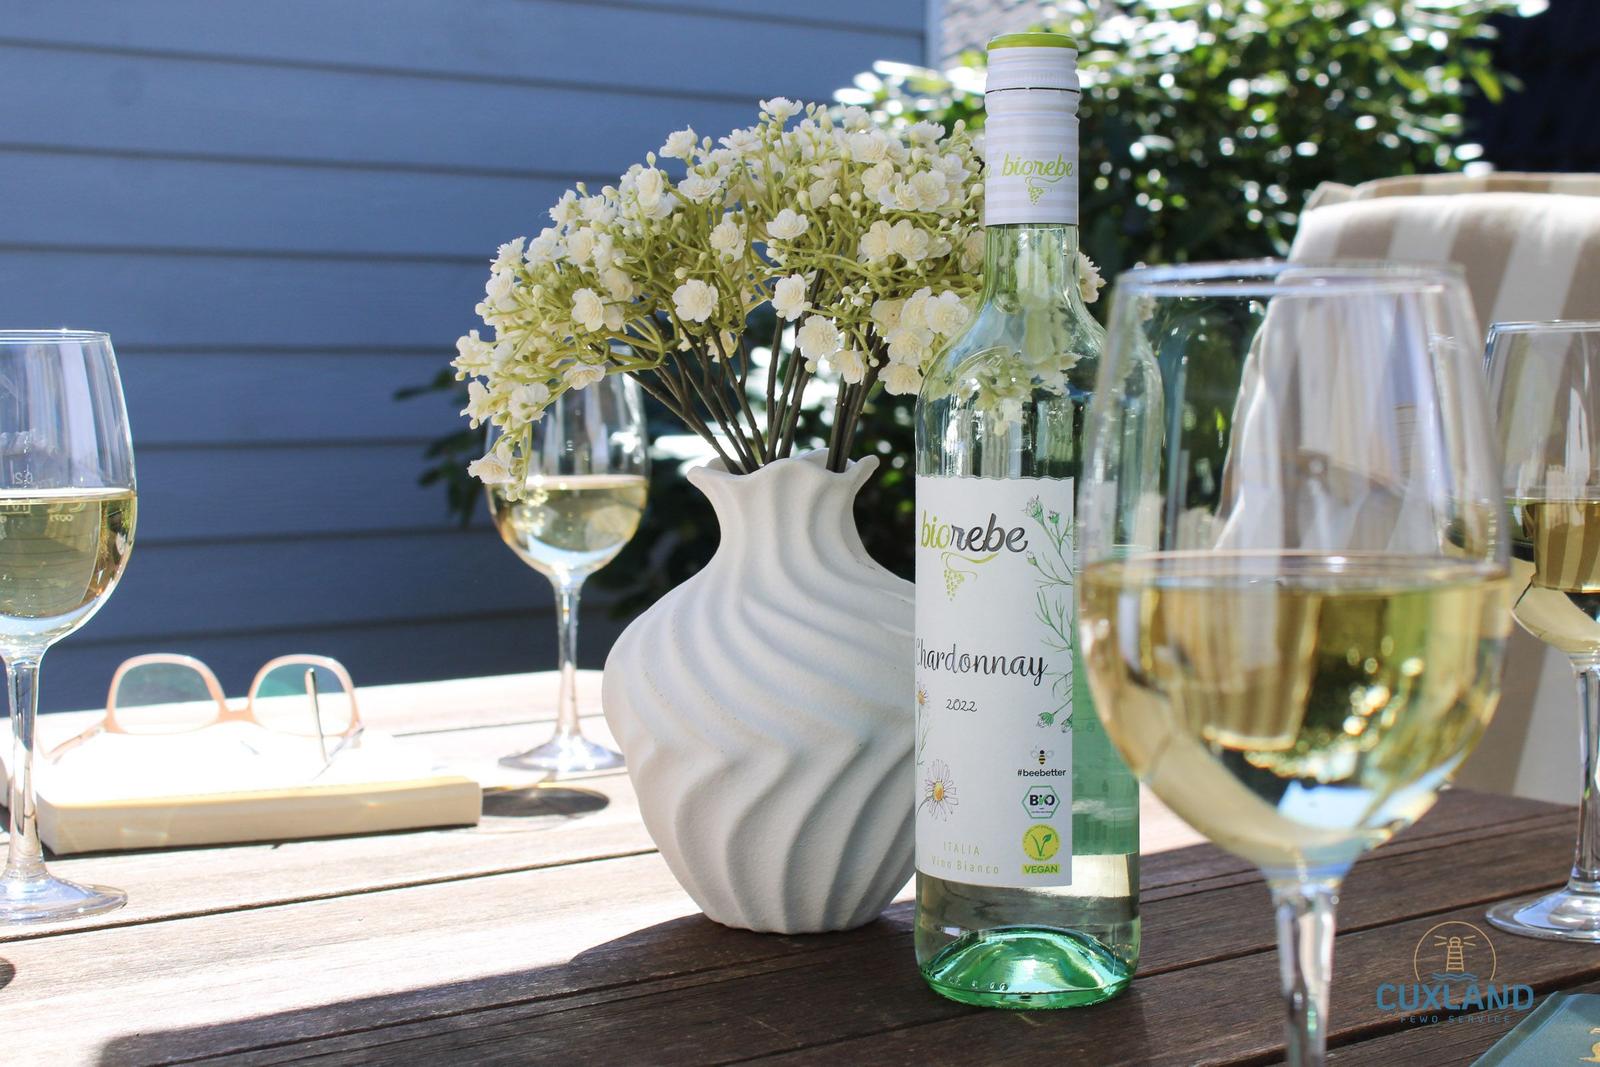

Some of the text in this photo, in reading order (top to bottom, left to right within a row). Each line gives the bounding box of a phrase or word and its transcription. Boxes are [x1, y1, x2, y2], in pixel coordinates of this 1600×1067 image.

[1001, 152, 1074, 177] biorebe
[920, 509, 1029, 553] biorebe
[945, 698, 978, 713] 2022
[1017, 768, 1067, 777] #beebetter
[943, 841, 981, 857] ITALIA
[956, 860, 1000, 875] Bianco
[1024, 864, 1058, 874] VEGAN
